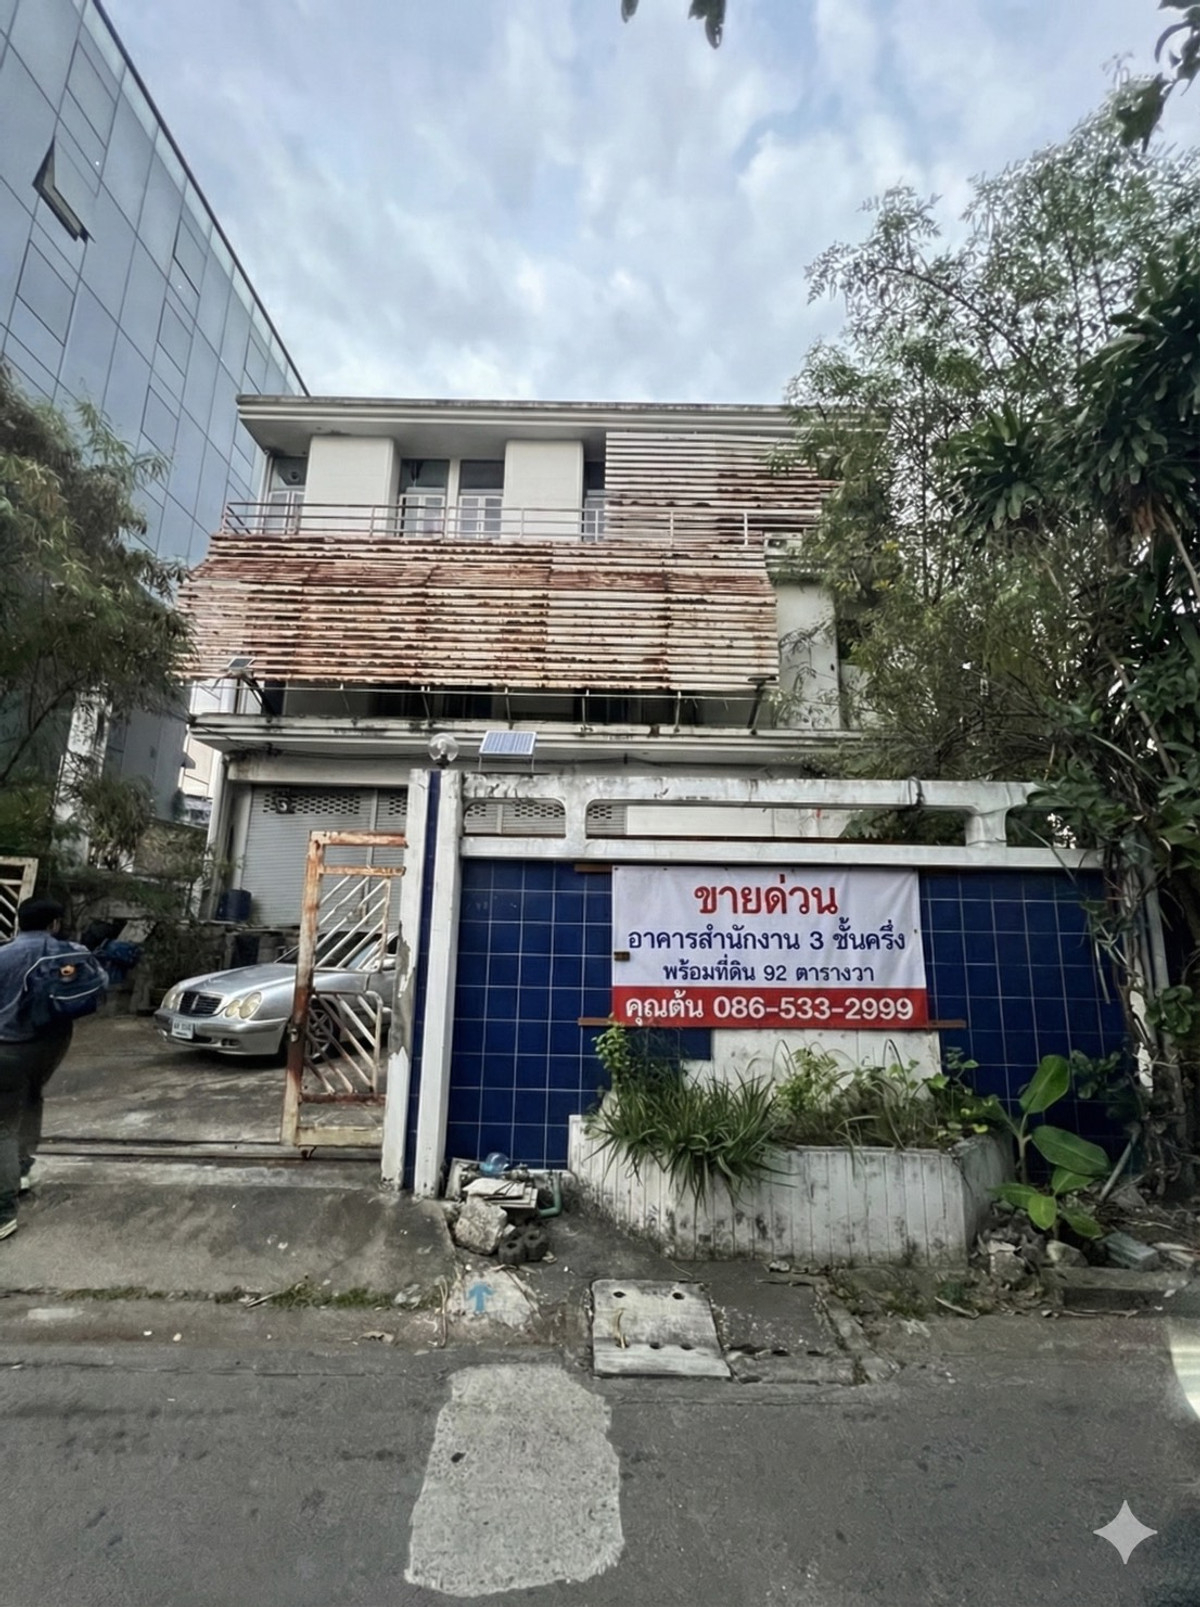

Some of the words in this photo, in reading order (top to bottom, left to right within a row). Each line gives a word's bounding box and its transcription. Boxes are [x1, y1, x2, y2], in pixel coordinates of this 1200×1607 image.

[694, 874, 838, 915] ขายด่วน
[628, 924, 800, 950] อาคารสำนักงาน
[809, 931, 824, 950] 3
[832, 916, 905, 950] ชั้นครึ่ง
[663, 954, 756, 981] พร้อมที่ดิน
[763, 965, 787, 981] 92
[796, 966, 875, 981] ตารางวา
[625, 989, 704, 1026] คุณต้น
[713, 996, 913, 1020] 086-533-2999
